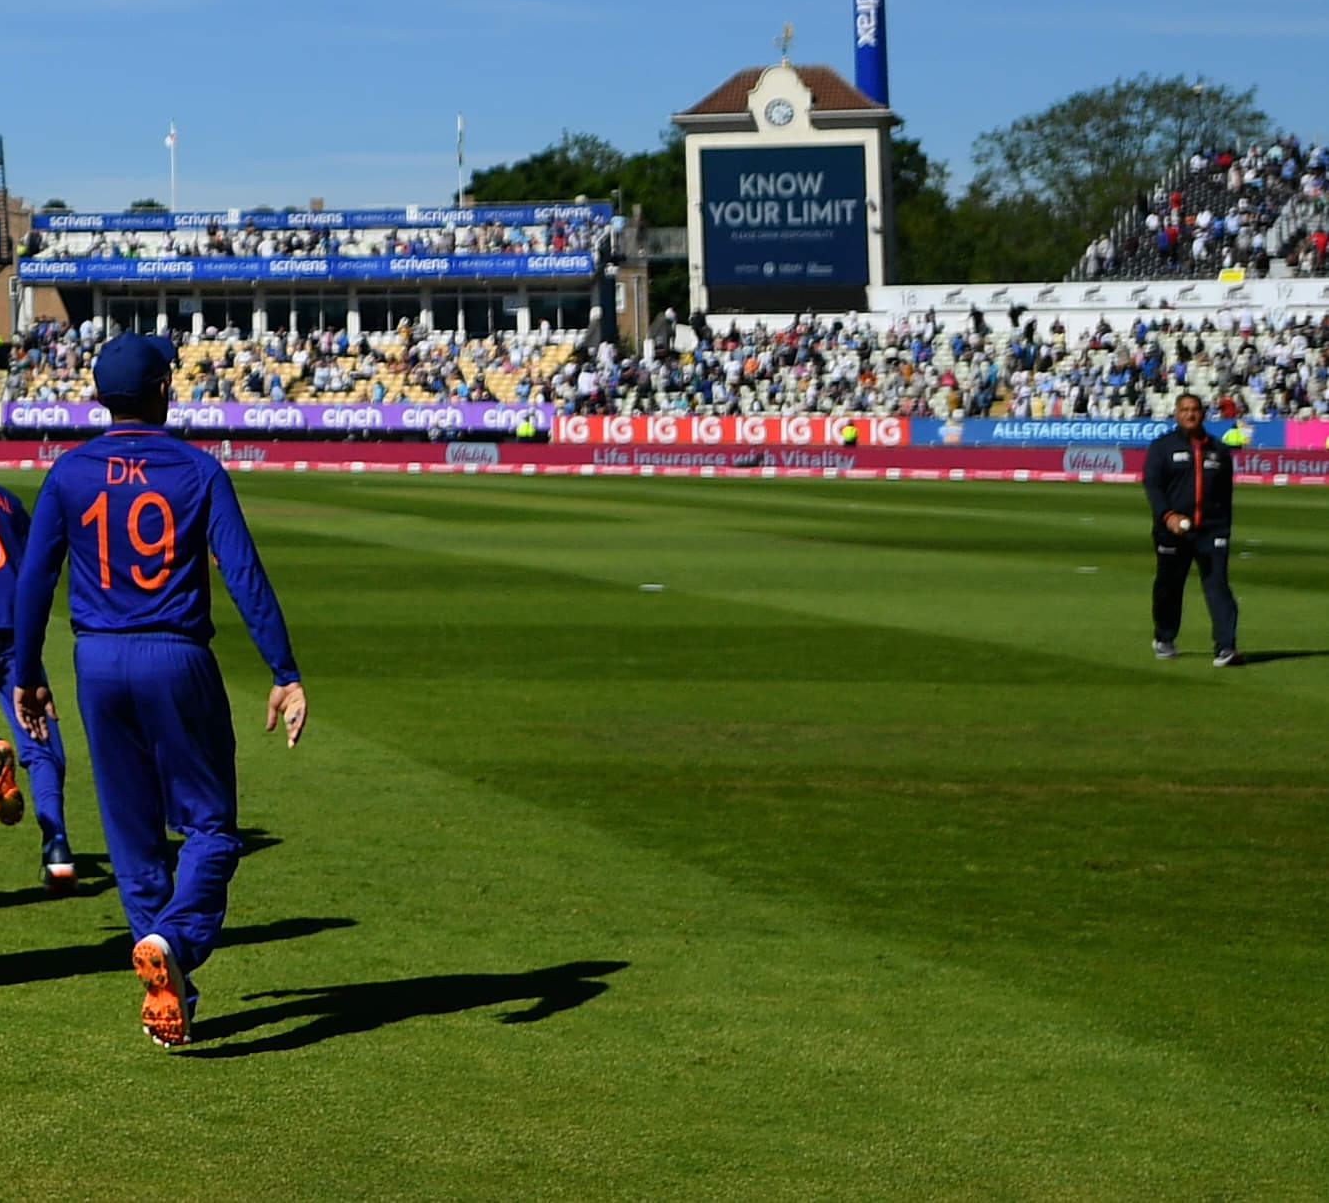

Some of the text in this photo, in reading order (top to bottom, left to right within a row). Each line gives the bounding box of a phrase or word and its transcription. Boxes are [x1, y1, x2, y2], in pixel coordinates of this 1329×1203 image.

[740, 171, 823, 197] KNOW
[49, 213, 103, 228] scrivens
[287, 212, 342, 226] scrivens
[417, 208, 474, 223] scrivens
[708, 199, 857, 226] YOUR LIMIT
[20, 260, 77, 275] scrivens
[137, 259, 194, 274] scrivens
[269, 258, 327, 273] scrivens
[390, 256, 449, 271] scrivens
[527, 254, 589, 270] scrivens
[11, 404, 70, 426] cinch
[243, 403, 304, 427] cinch
[322, 405, 383, 428] cinch
[402, 405, 463, 428] cinch
[558, 416, 590, 444] IG
[602, 416, 633, 445] IG
[646, 416, 680, 445] IG
[692, 416, 724, 445] IG
[735, 416, 767, 446] IG
[780, 416, 812, 445] IG
[870, 417, 902, 447] IG
[993, 421, 1171, 440] ALLSTARSCRICKET.CO
[202, 445, 266, 463] Viality
[593, 448, 856, 470] Life insurance wih Vitality
[1232, 454, 1272, 473] Life
[106, 456, 148, 486] DK
[80, 490, 176, 592] 19
